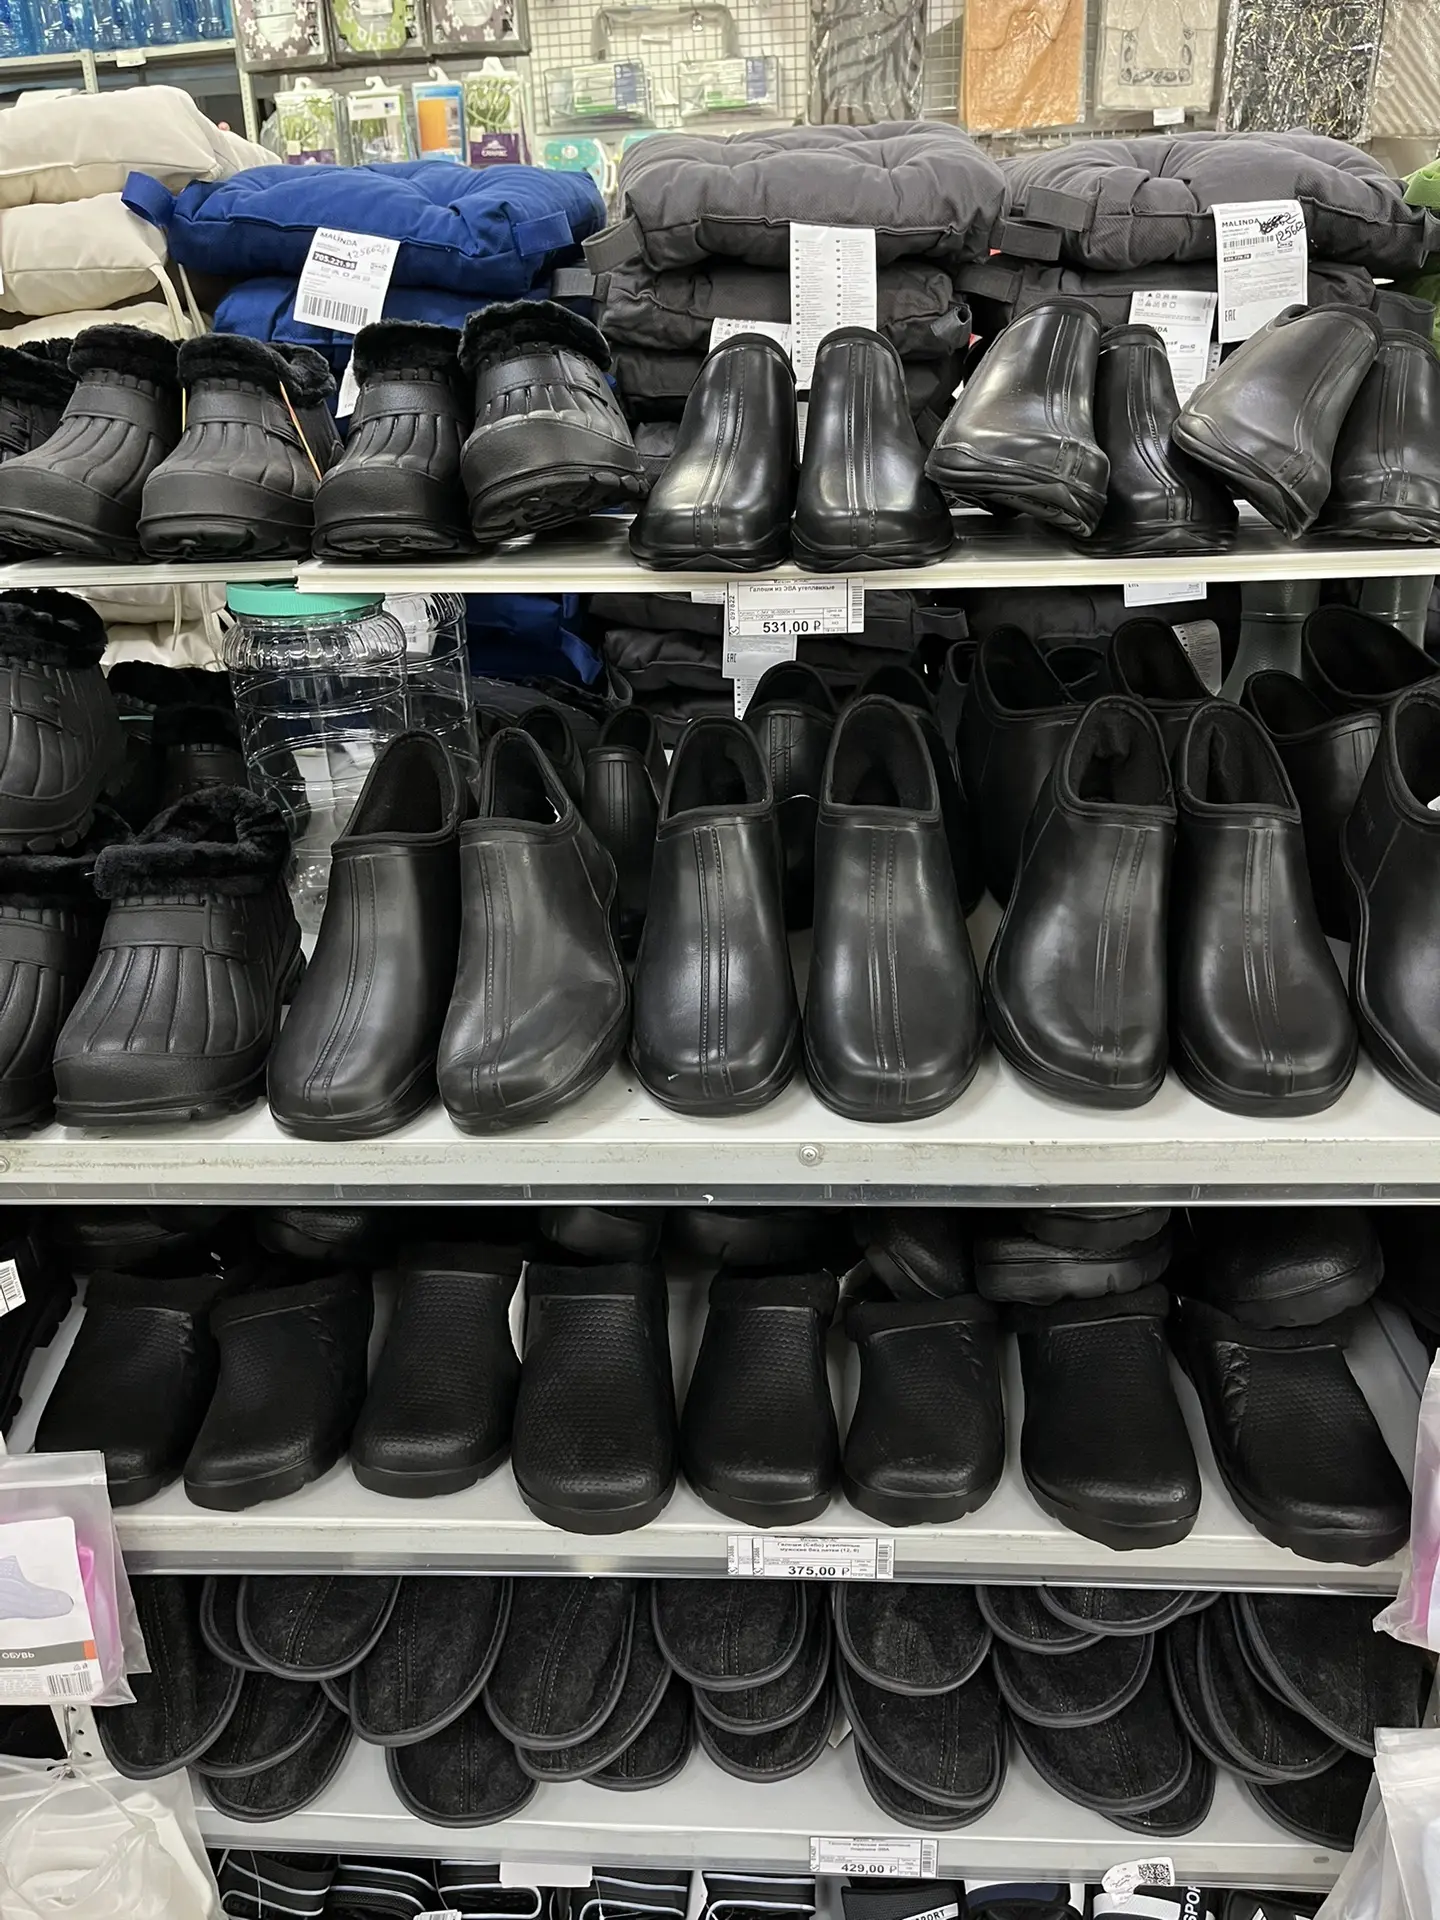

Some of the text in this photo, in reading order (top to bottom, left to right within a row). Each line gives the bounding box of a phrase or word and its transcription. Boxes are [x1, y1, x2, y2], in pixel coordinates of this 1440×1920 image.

[1221, 218, 1259, 228] MALINDA
[320, 232, 357, 246] MALINDA
[762, 621, 809, 634] 531,00
[788, 1566, 836, 1576] 375,00
[1, 1652, 35, 1660] ОБУВЬ
[841, 1864, 885, 1875] 429,00
